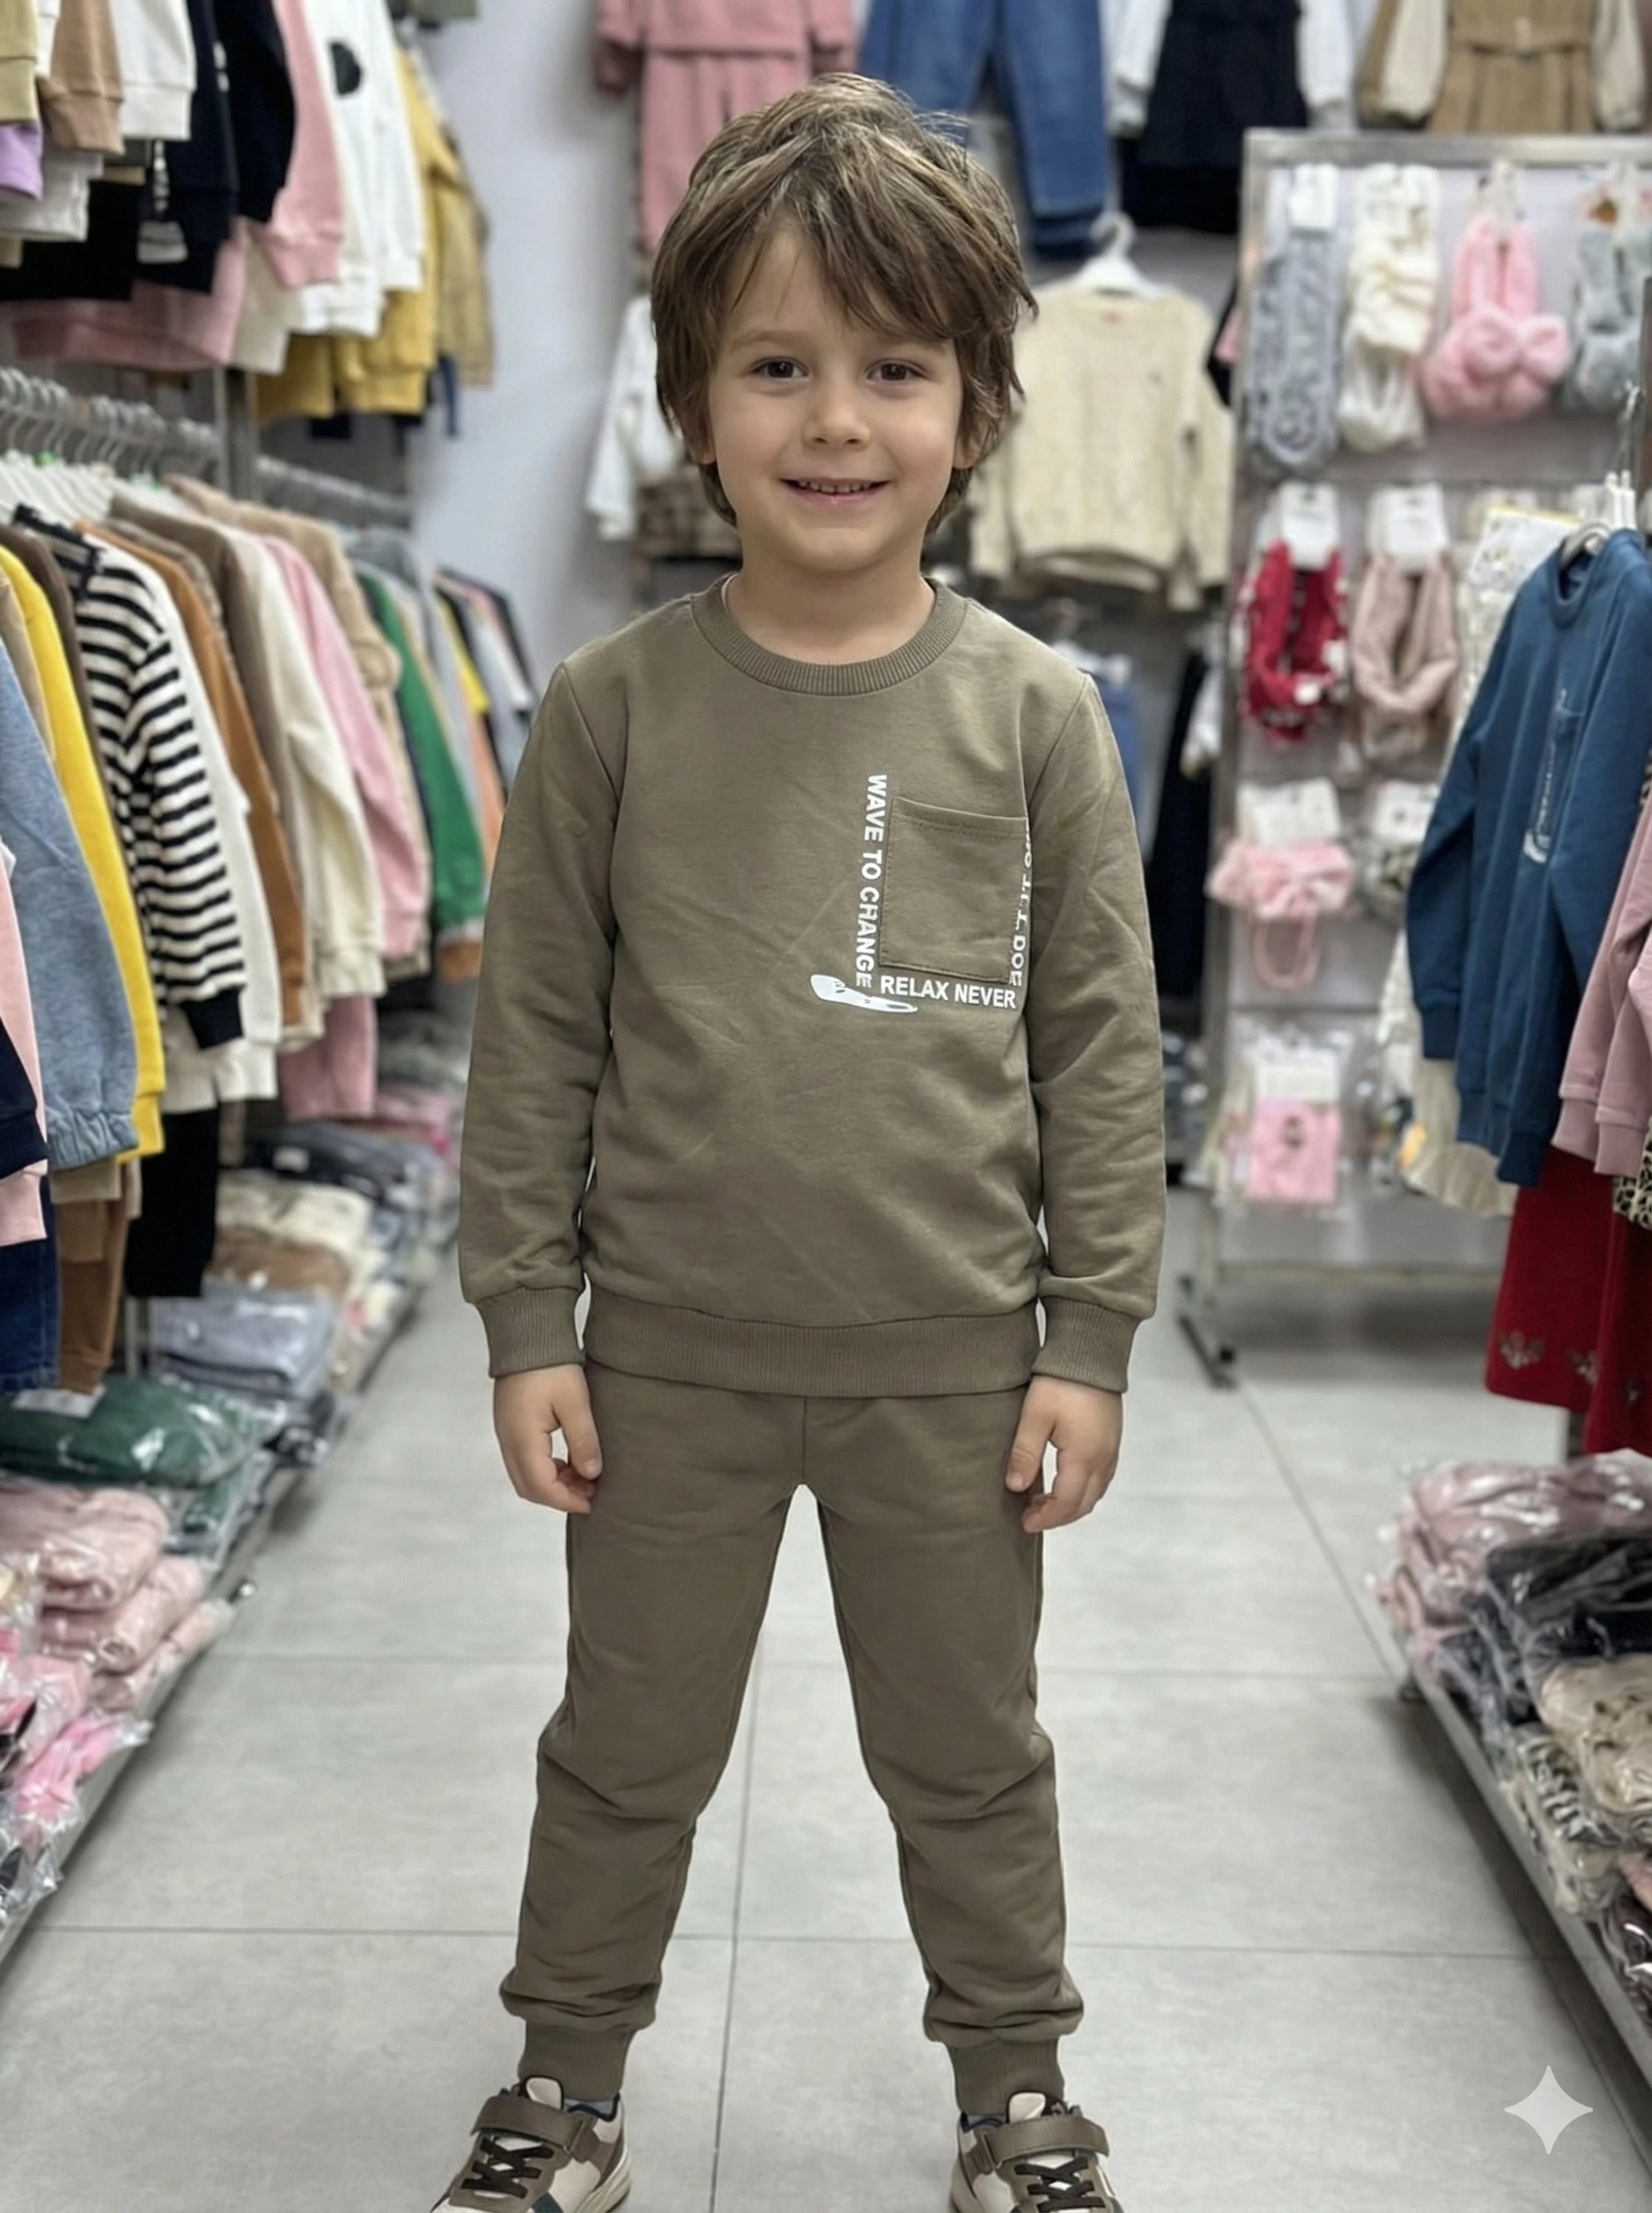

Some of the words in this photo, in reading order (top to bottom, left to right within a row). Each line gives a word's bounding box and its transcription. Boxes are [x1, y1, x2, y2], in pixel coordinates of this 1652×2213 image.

[865, 775, 887, 841] WAVE
[861, 849, 882, 880] TO
[856, 886, 879, 988] CHANGE
[880, 975, 950, 1001] RELAX
[954, 983, 1016, 1010] NEVER
